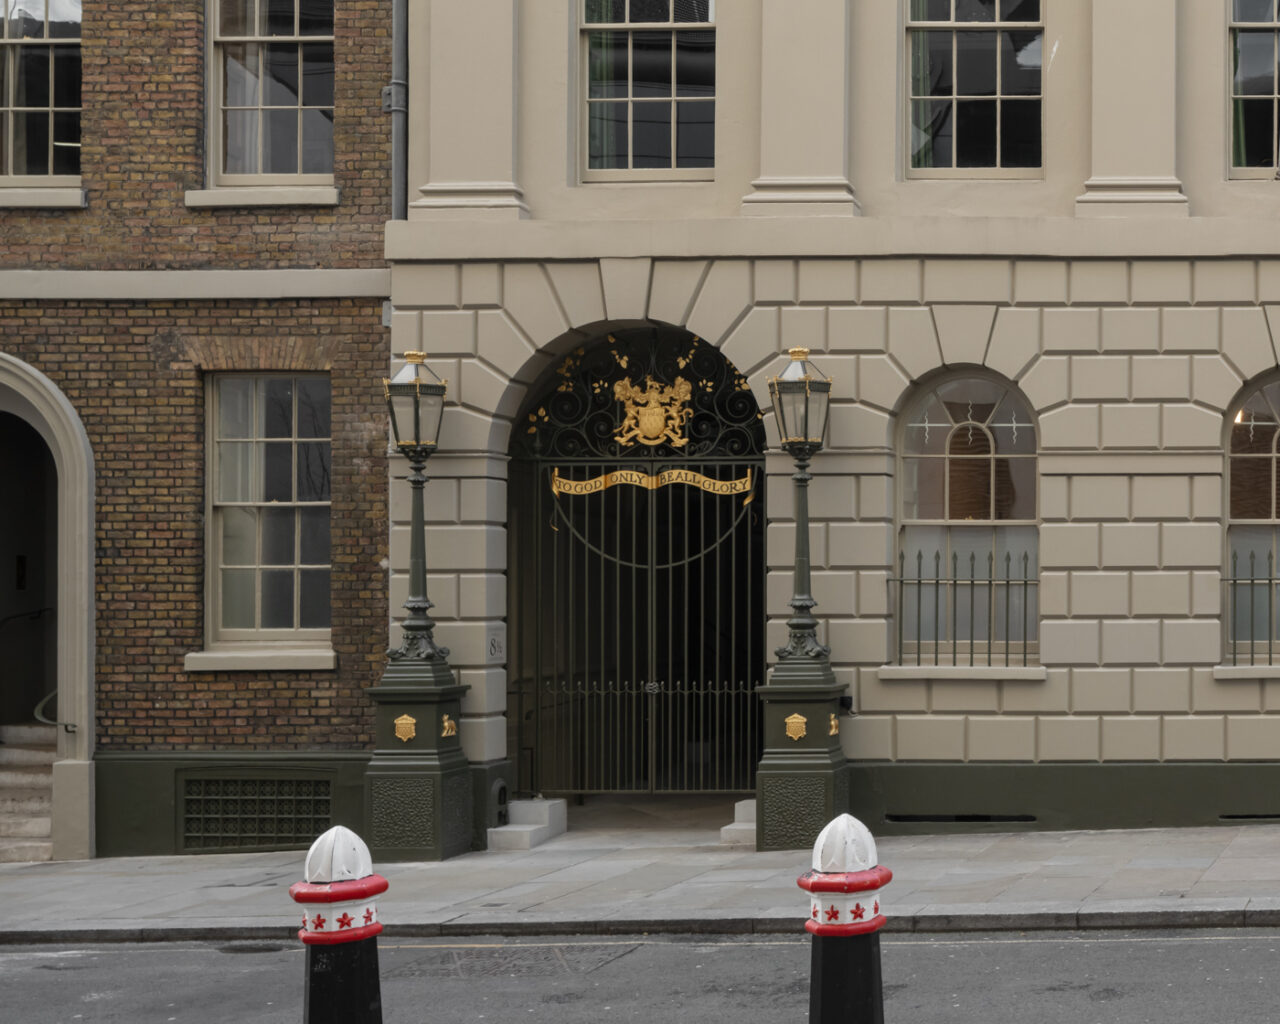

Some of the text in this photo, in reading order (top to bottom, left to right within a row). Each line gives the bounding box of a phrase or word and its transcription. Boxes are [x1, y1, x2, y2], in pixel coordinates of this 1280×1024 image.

[556, 472, 748, 494] TO GOD ONLY BE ALL GLORY
